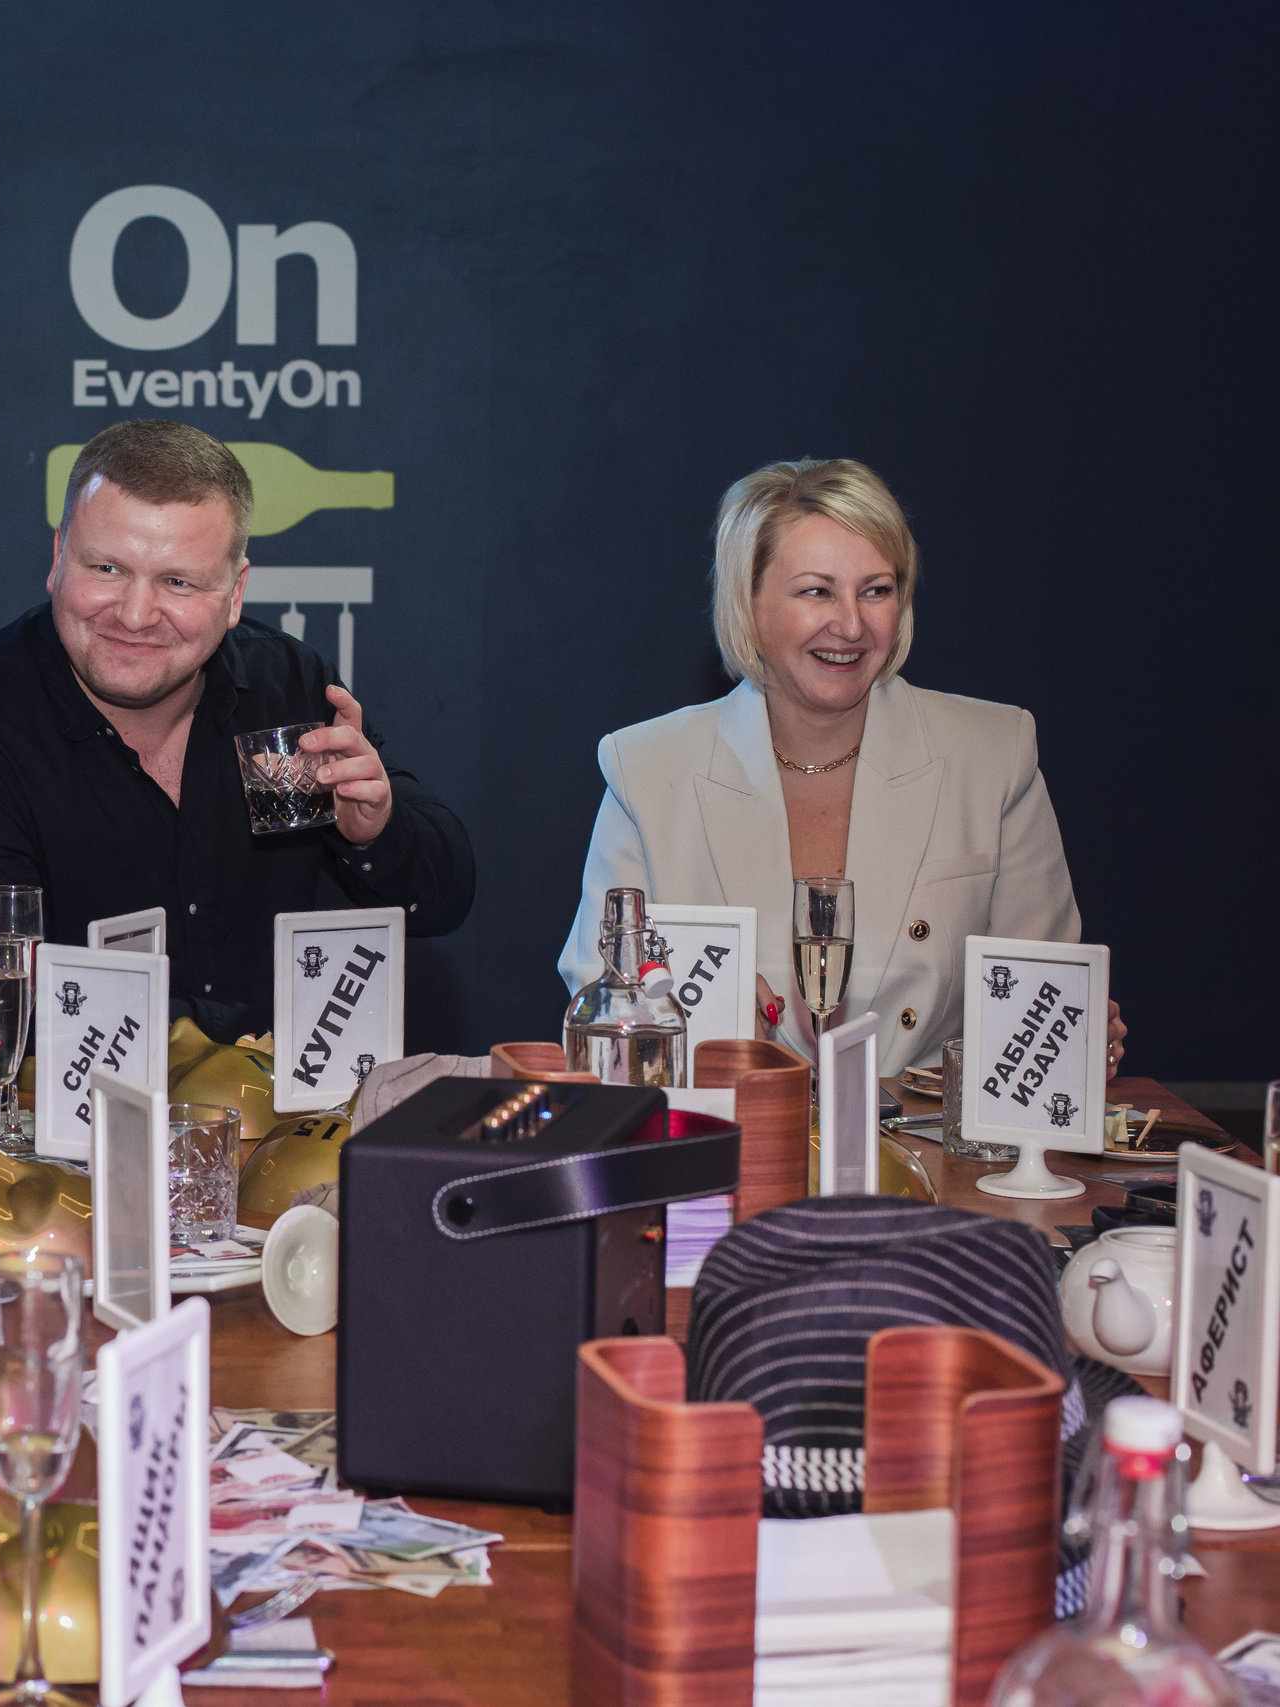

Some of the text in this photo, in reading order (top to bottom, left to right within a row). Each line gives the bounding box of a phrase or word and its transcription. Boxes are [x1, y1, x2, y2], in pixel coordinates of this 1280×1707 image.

[69, 184, 358, 351] On
[73, 360, 362, 420] EventyOn
[292, 943, 387, 1088] КУПЕЦ
[678, 944, 731, 1019] ОТА
[982, 981, 1062, 1099] РАБЫНЯ
[62, 1024, 106, 1092] СЫН
[1010, 1003, 1085, 1108] ИЗАУРА
[292, 1119, 343, 1140] 15
[1192, 1216, 1255, 1404] АФЕРИСТ
[129, 1427, 163, 1590] ЯЩИК
[134, 1380, 188, 1646] ПАНДОРЫ
